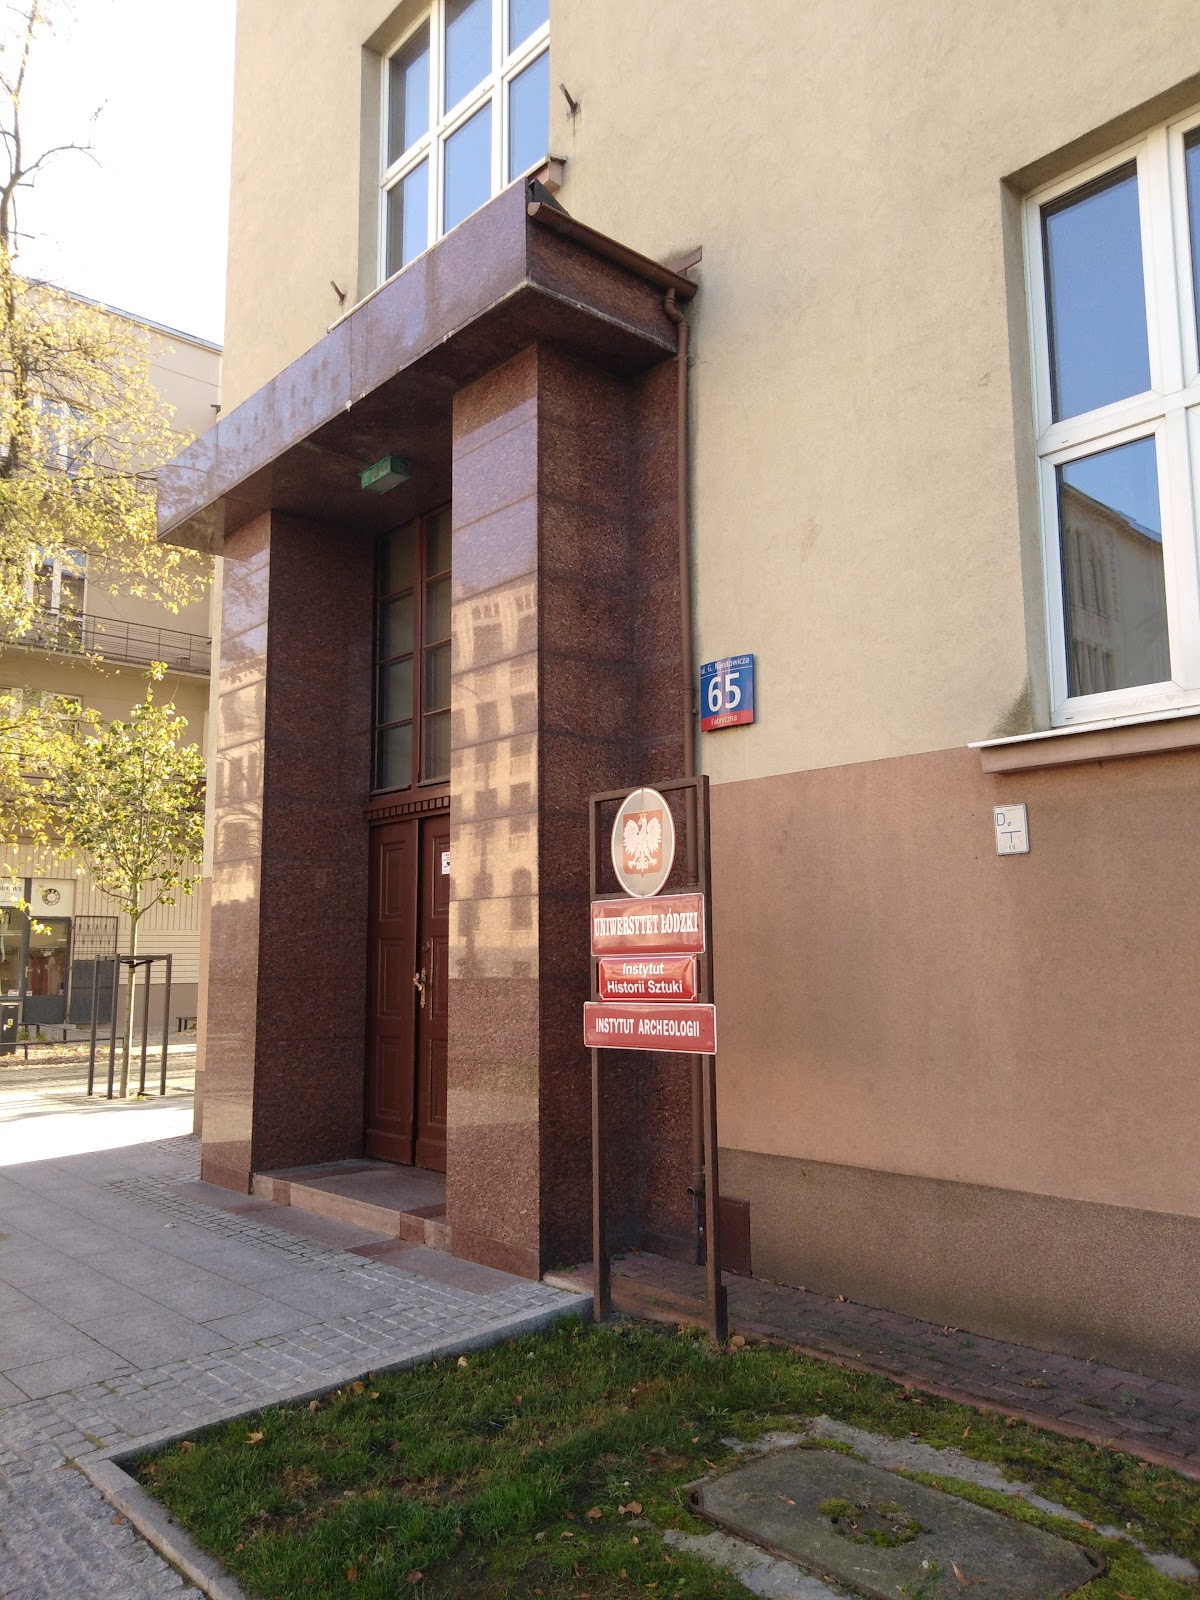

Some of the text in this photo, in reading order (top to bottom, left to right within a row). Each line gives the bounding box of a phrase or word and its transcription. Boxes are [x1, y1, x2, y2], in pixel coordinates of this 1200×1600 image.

[714, 657, 750, 670] Narutowicza
[708, 672, 741, 712] 65
[711, 714, 738, 726] Fabryczna
[594, 907, 698, 936] UNIWERSYTET ŁÓDZKI
[622, 963, 664, 977] Instytut
[607, 980, 683, 993] Historii Sztuki
[595, 1017, 700, 1037] INSTYTUT ARCHEOLOGII
